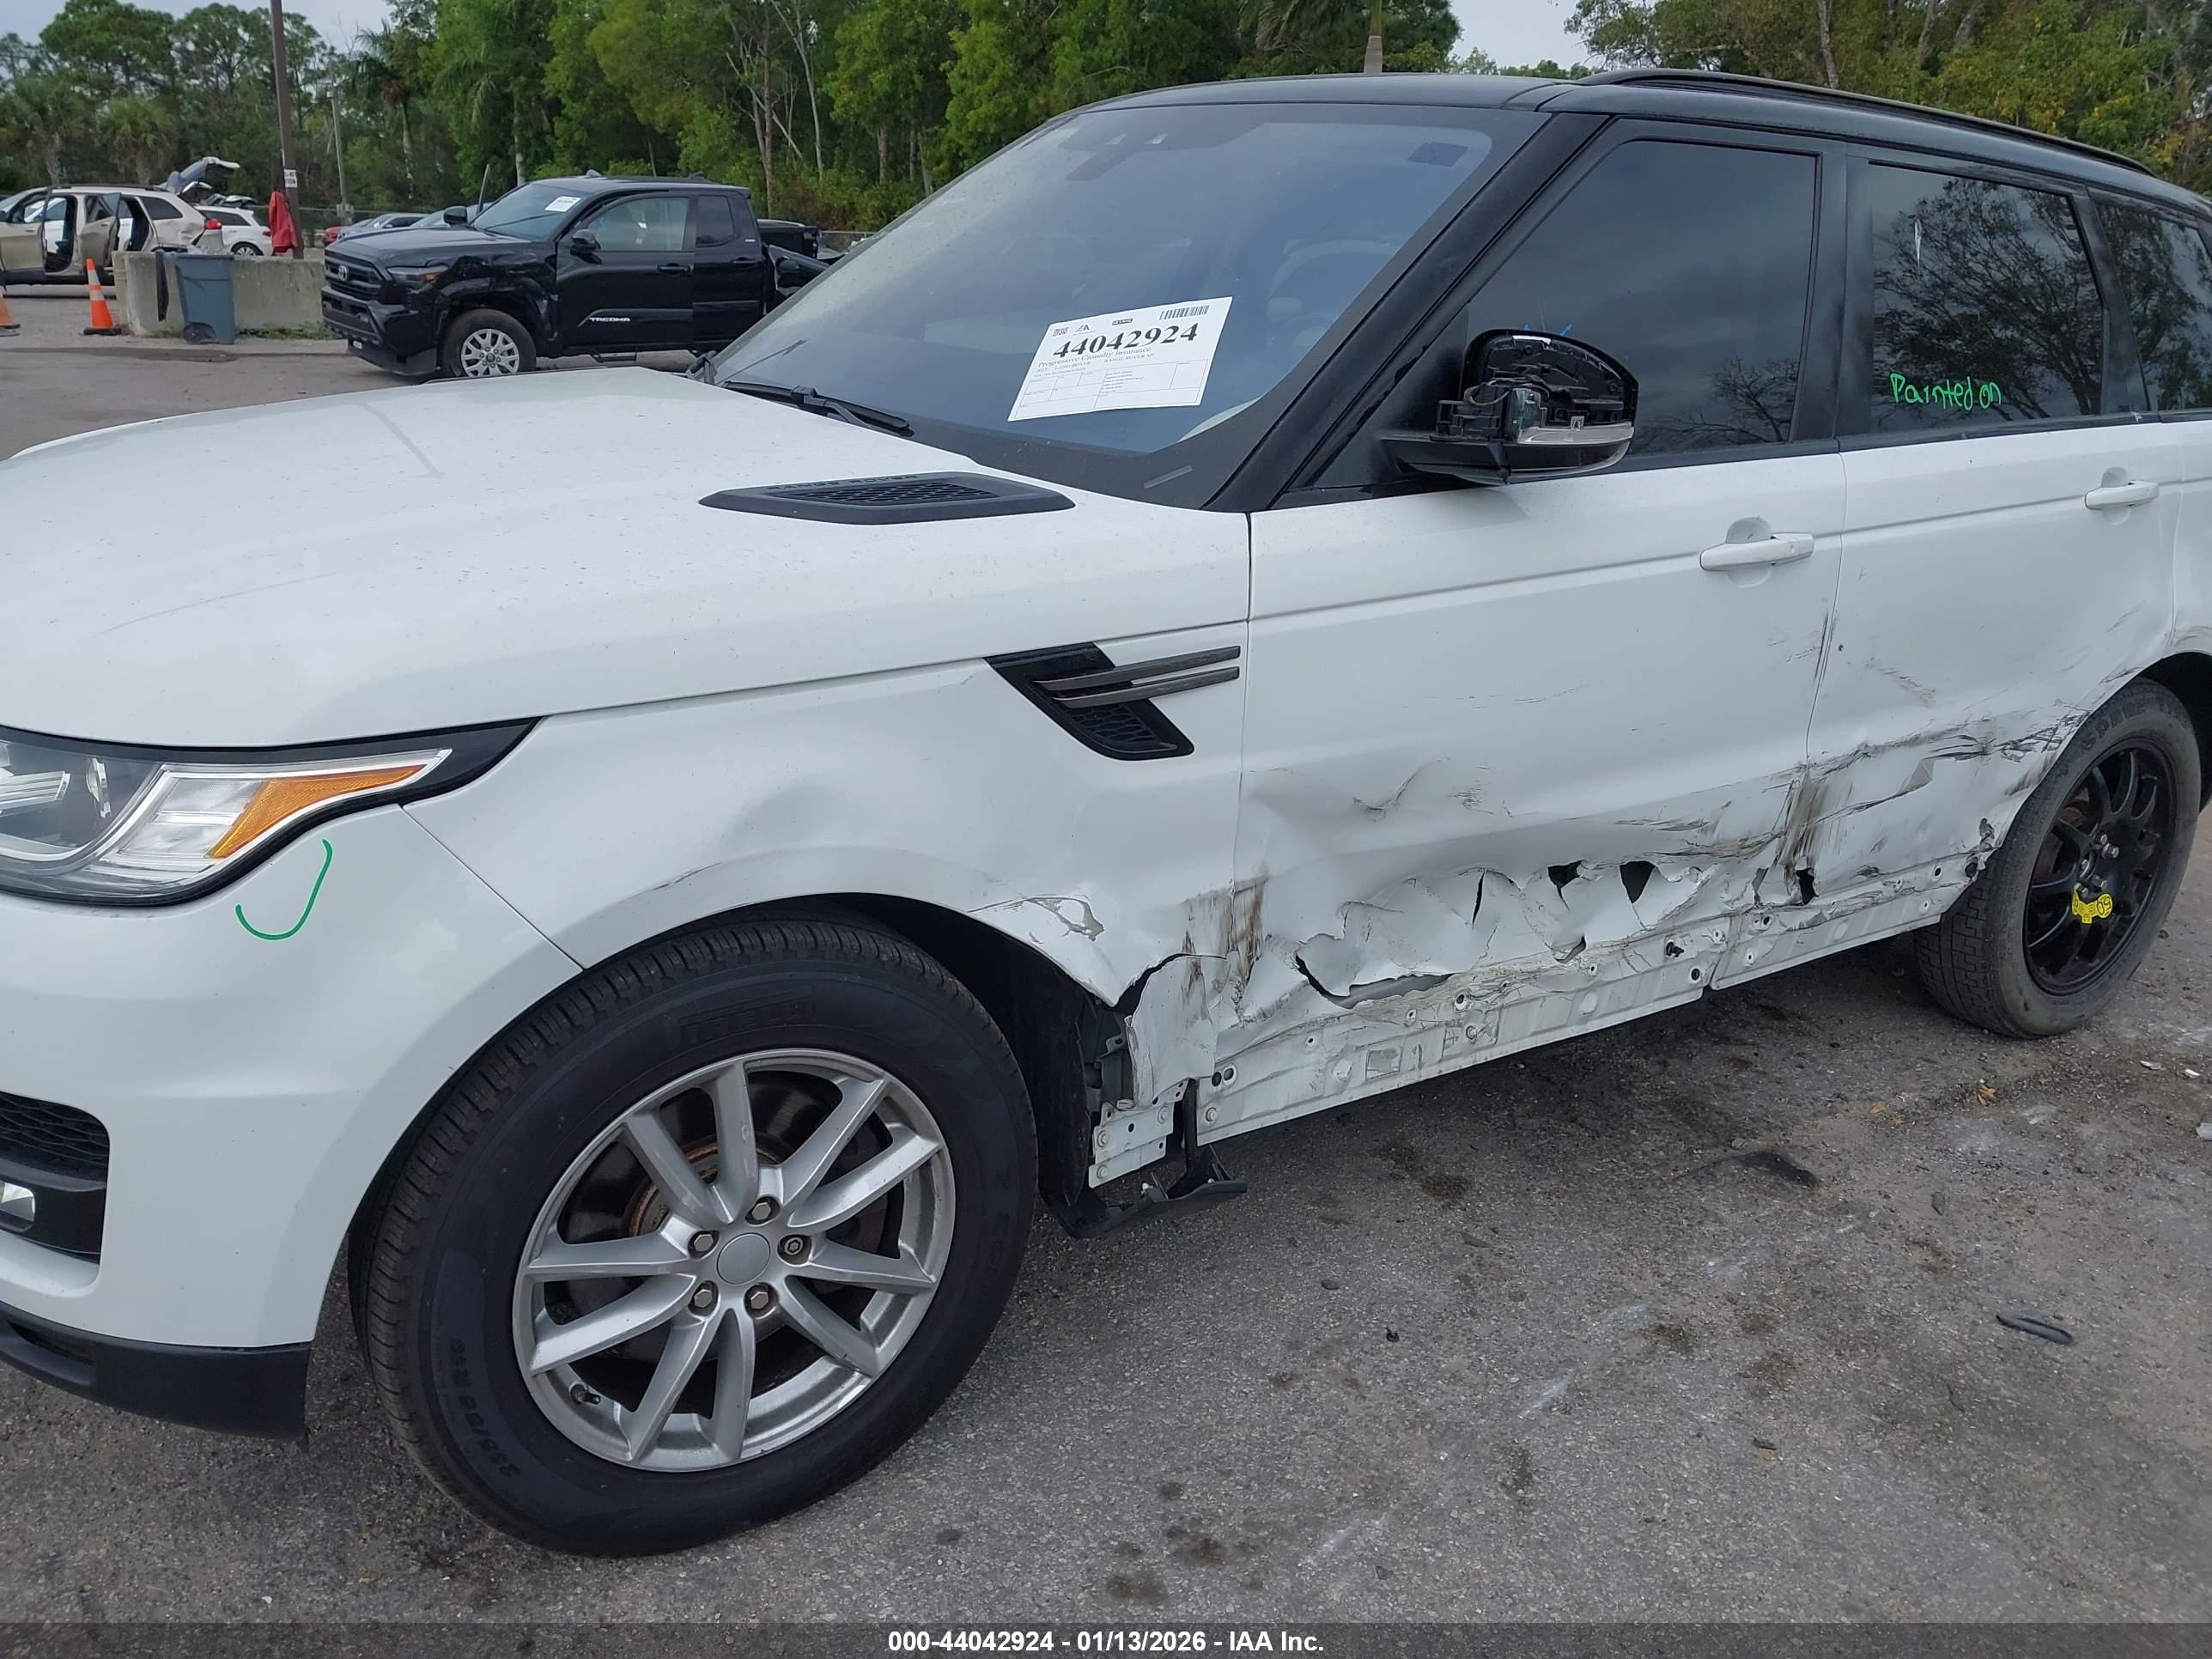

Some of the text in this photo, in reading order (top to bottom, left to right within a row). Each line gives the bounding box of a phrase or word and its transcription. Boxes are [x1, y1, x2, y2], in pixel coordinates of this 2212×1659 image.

[1053, 323, 1199, 357] 44042924
[1038, 357, 1079, 368] Progressive
[1081, 352, 1114, 362] Casualty
[1890, 373, 2002, 410] Painted on
